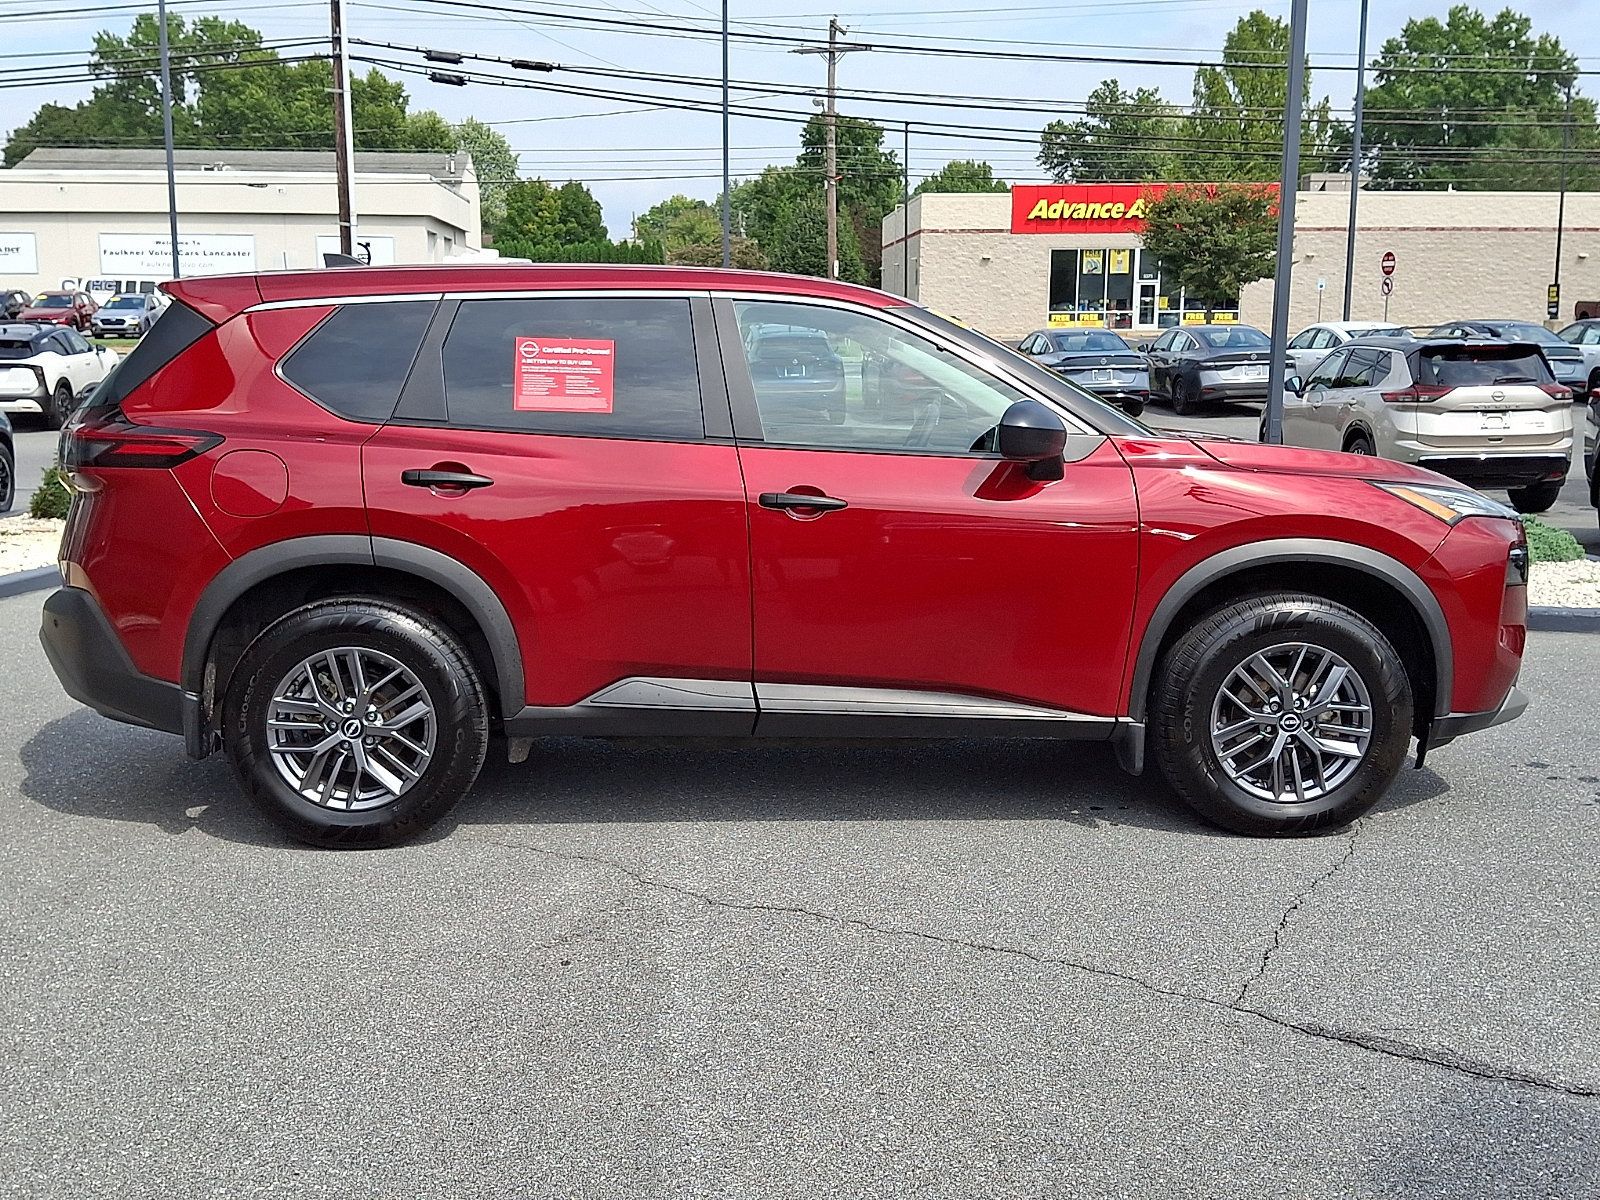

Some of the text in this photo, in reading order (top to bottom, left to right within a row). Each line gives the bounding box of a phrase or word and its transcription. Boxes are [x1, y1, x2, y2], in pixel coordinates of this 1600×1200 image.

[1027, 199, 1125, 220] Advance
[1051, 314, 1070, 322] FREE
[1079, 313, 1098, 321] FREE
[542, 346, 572, 354] Certified
[572, 347, 611, 355] Pre-Owned
